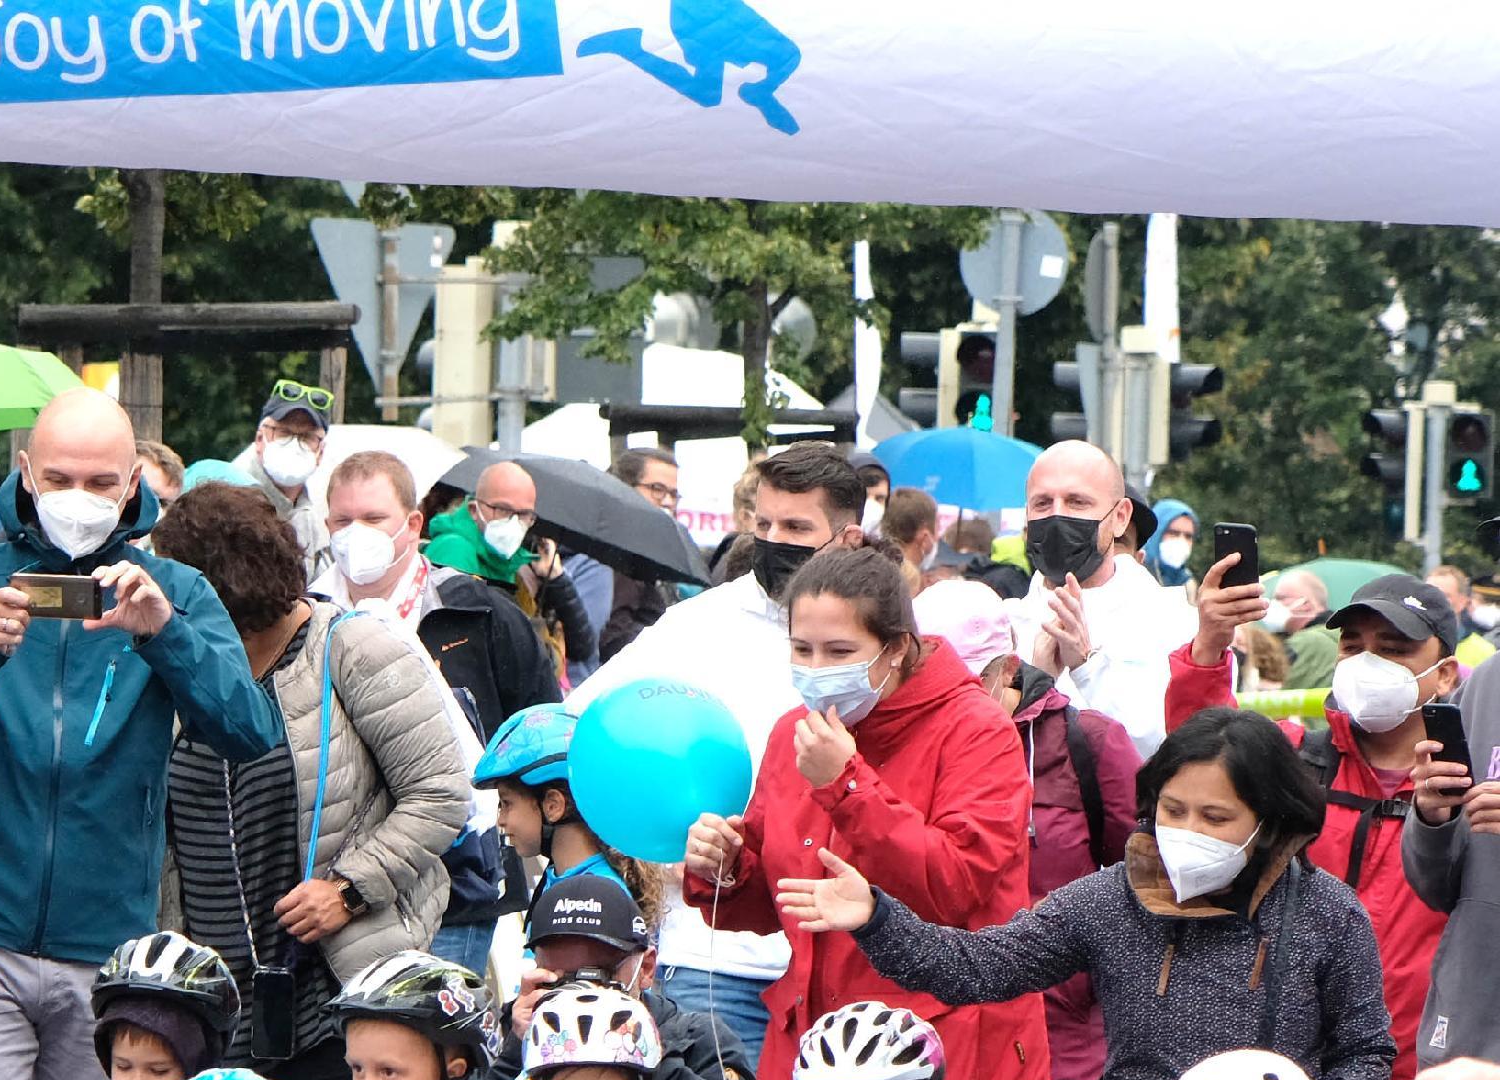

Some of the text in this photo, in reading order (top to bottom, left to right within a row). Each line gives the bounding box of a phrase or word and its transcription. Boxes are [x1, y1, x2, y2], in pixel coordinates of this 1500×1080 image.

[130, 0, 202, 63] of
[235, 0, 521, 61] moving
[553, 898, 602, 914] Alpecin
[576, 917, 602, 925] CLUB
